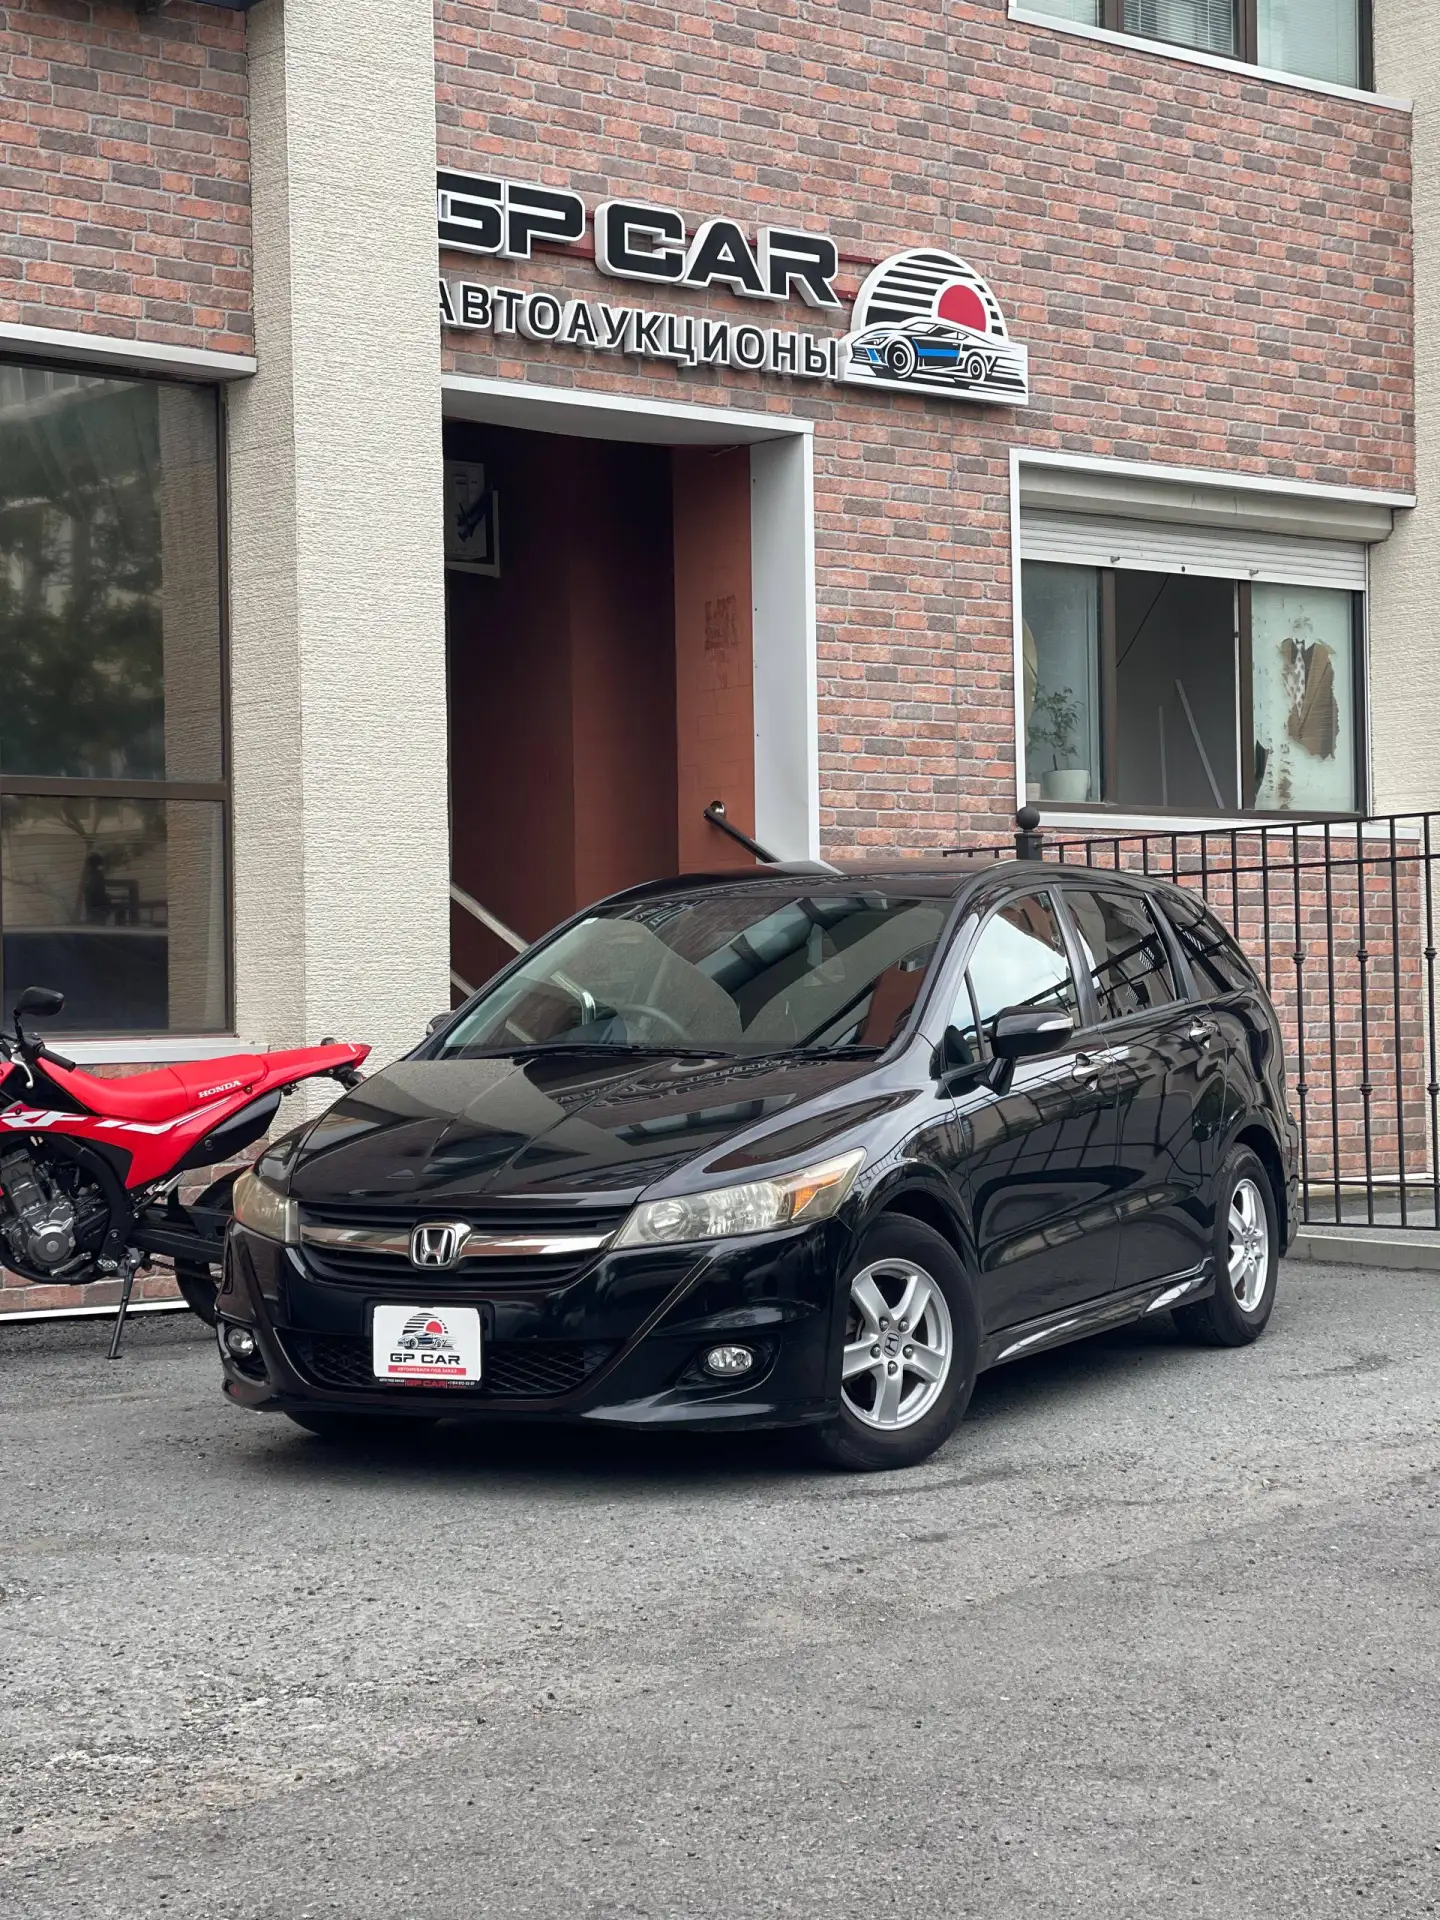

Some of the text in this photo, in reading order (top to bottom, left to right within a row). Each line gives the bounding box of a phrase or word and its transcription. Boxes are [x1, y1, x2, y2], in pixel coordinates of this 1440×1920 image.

[437, 168, 843, 309] GP CAR
[198, 1080, 242, 1098] HONDA
[390, 1353, 461, 1365] GP CAR
